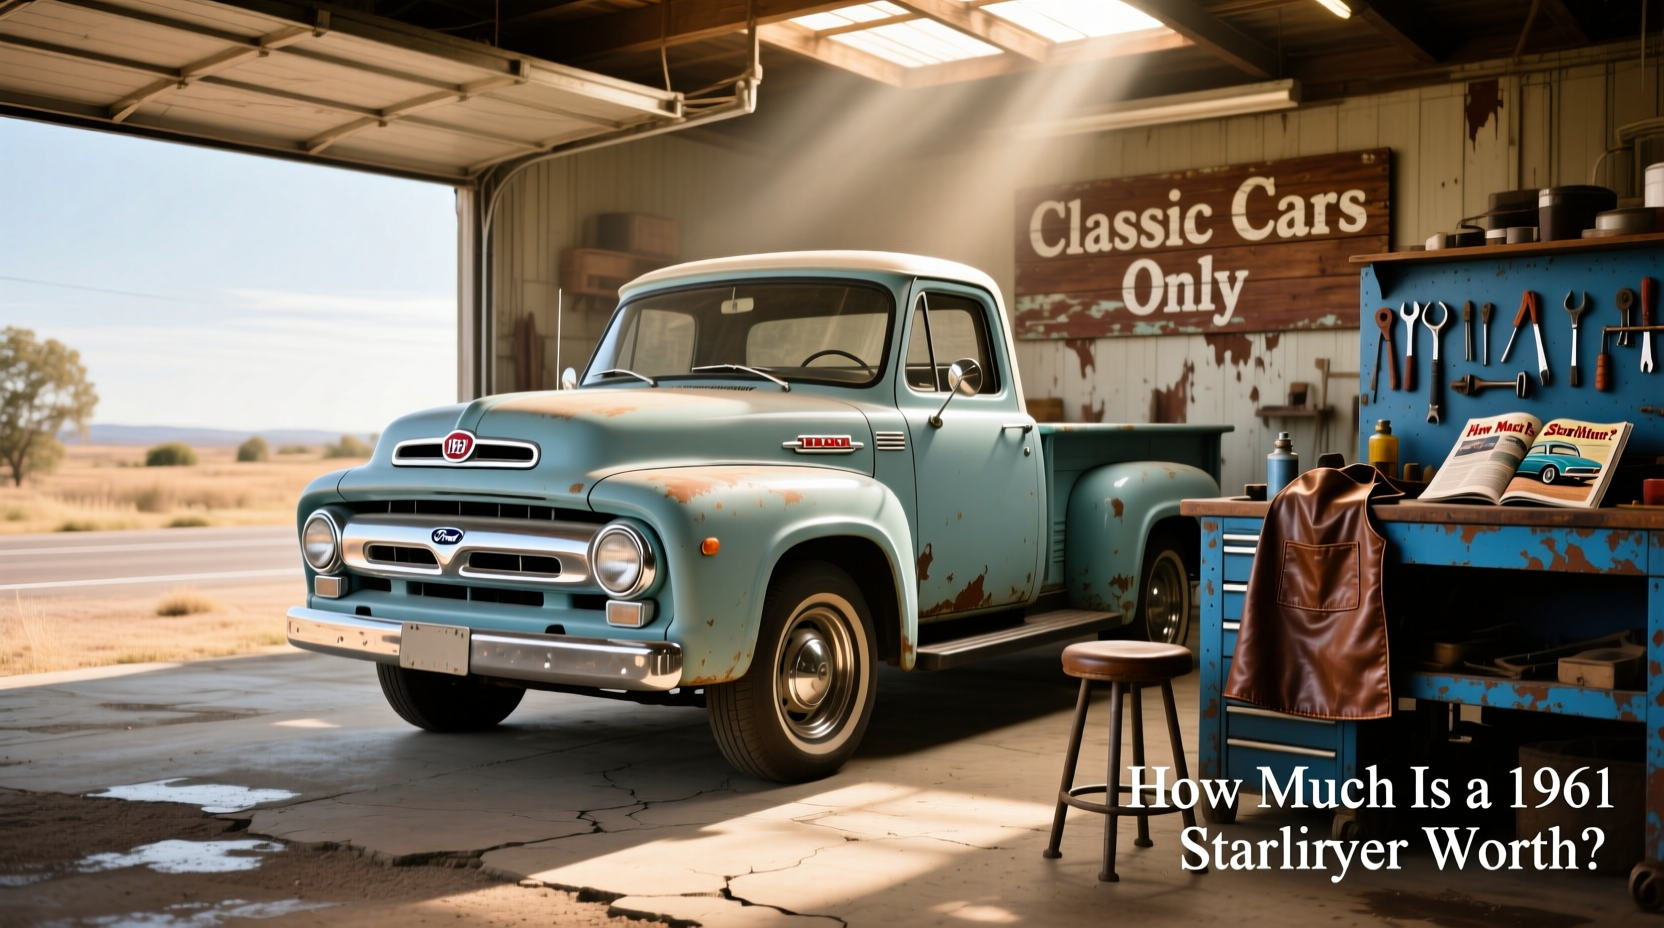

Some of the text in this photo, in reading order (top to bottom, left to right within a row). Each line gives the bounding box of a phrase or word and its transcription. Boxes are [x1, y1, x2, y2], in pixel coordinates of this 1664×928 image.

[1029, 176, 1368, 258] Classic Cars
[1121, 254, 1249, 326] Only
